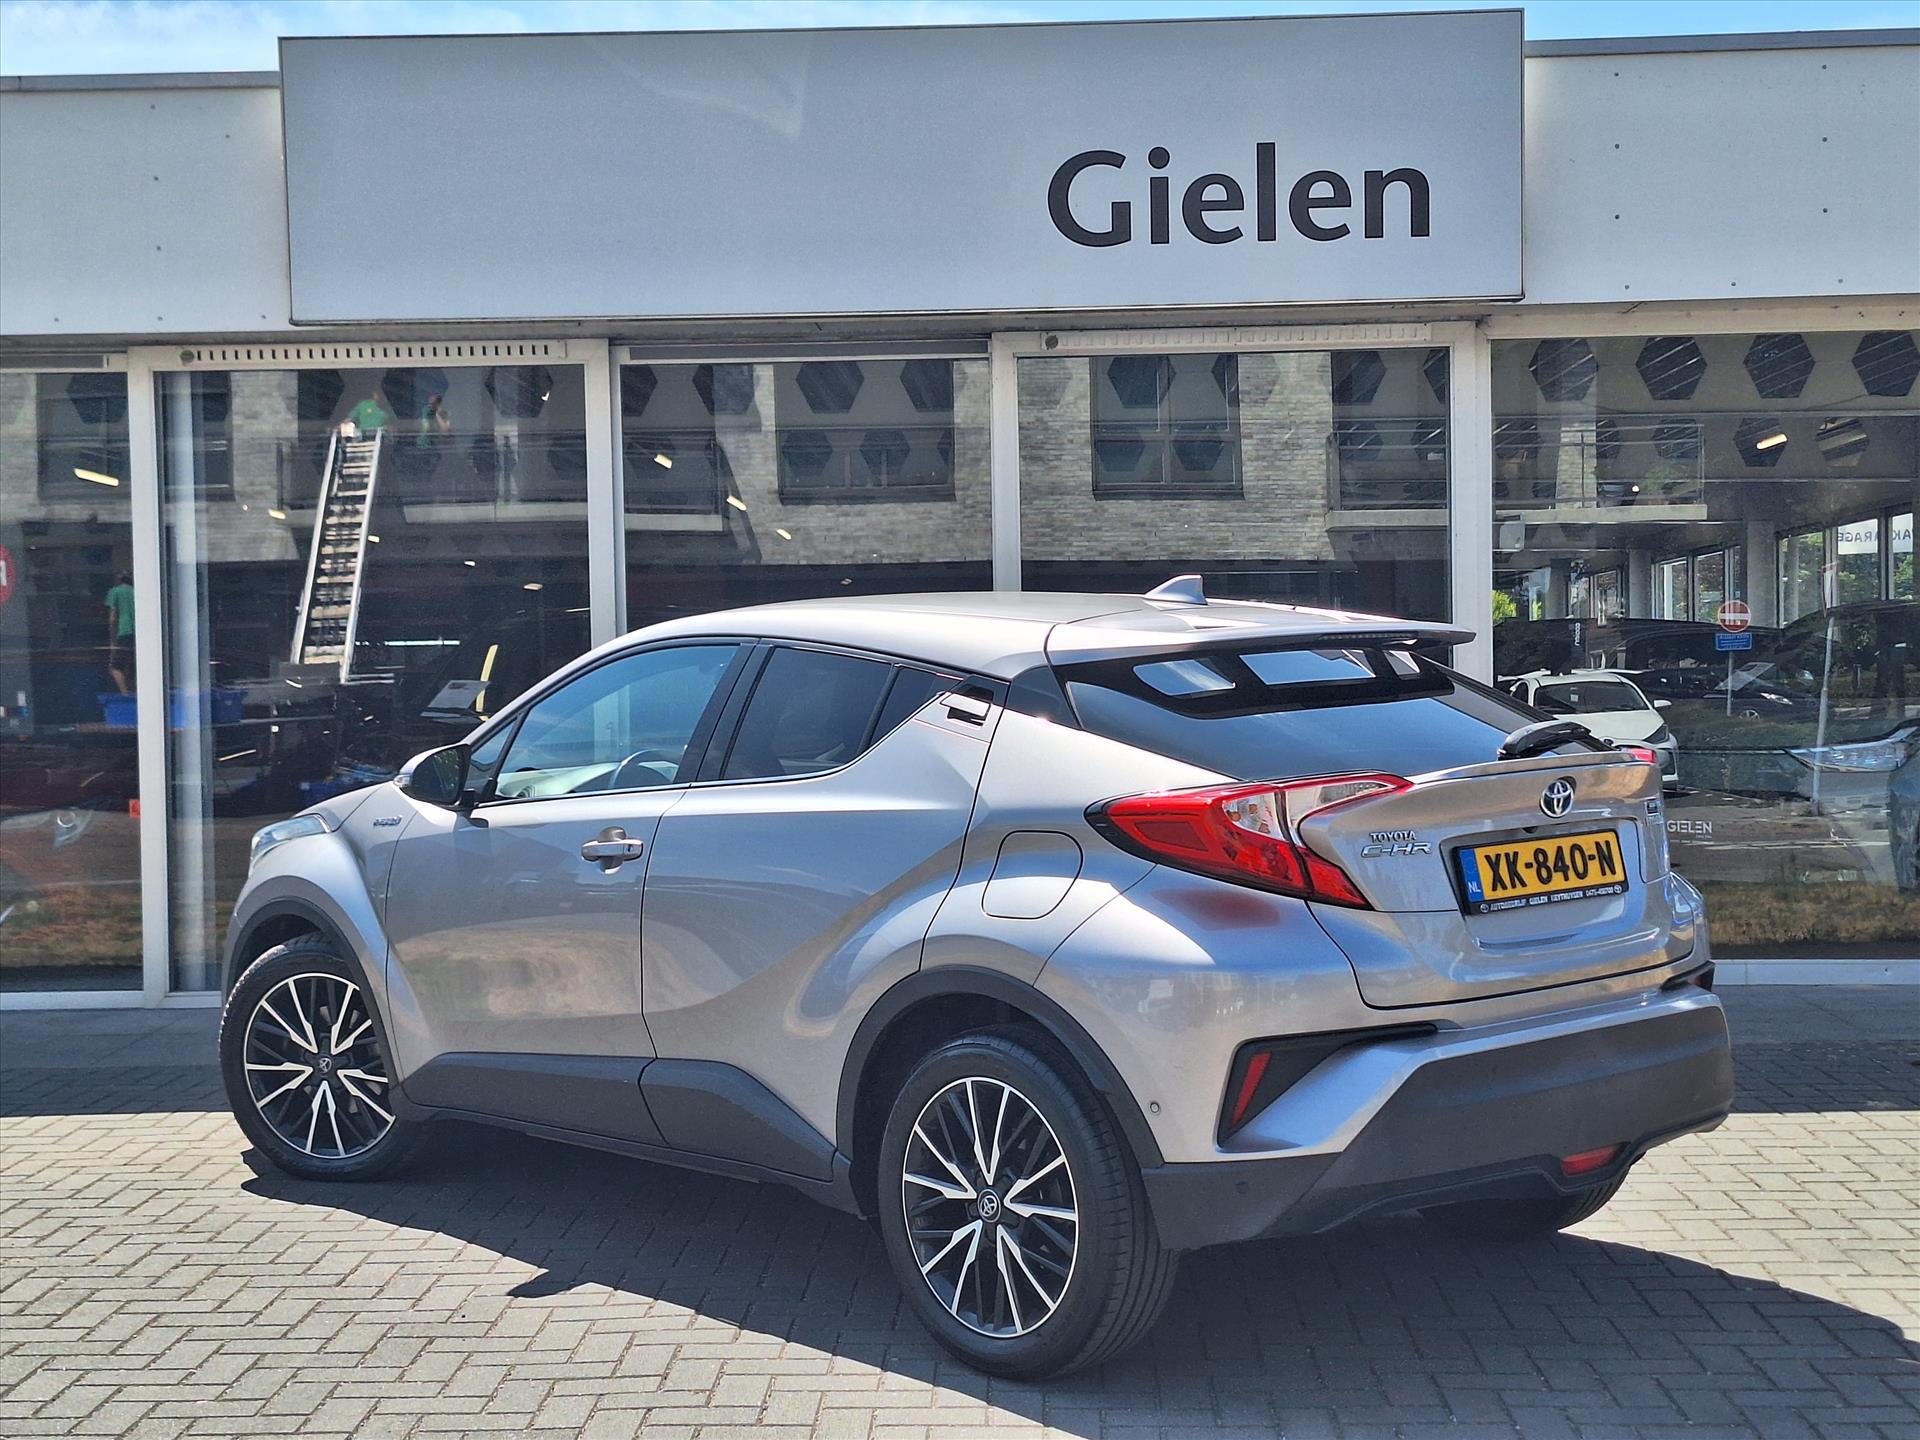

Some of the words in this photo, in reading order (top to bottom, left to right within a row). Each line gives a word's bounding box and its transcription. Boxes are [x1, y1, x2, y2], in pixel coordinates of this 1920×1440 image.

[1047, 141, 1430, 248] Gielen
[1666, 820, 1712, 834] GIELEN
[1370, 830, 1416, 843] TOYOTA
[1361, 842, 1431, 858] C-HR
[1484, 840, 1617, 892] XK-840-N
[1468, 881, 1482, 893] NL
